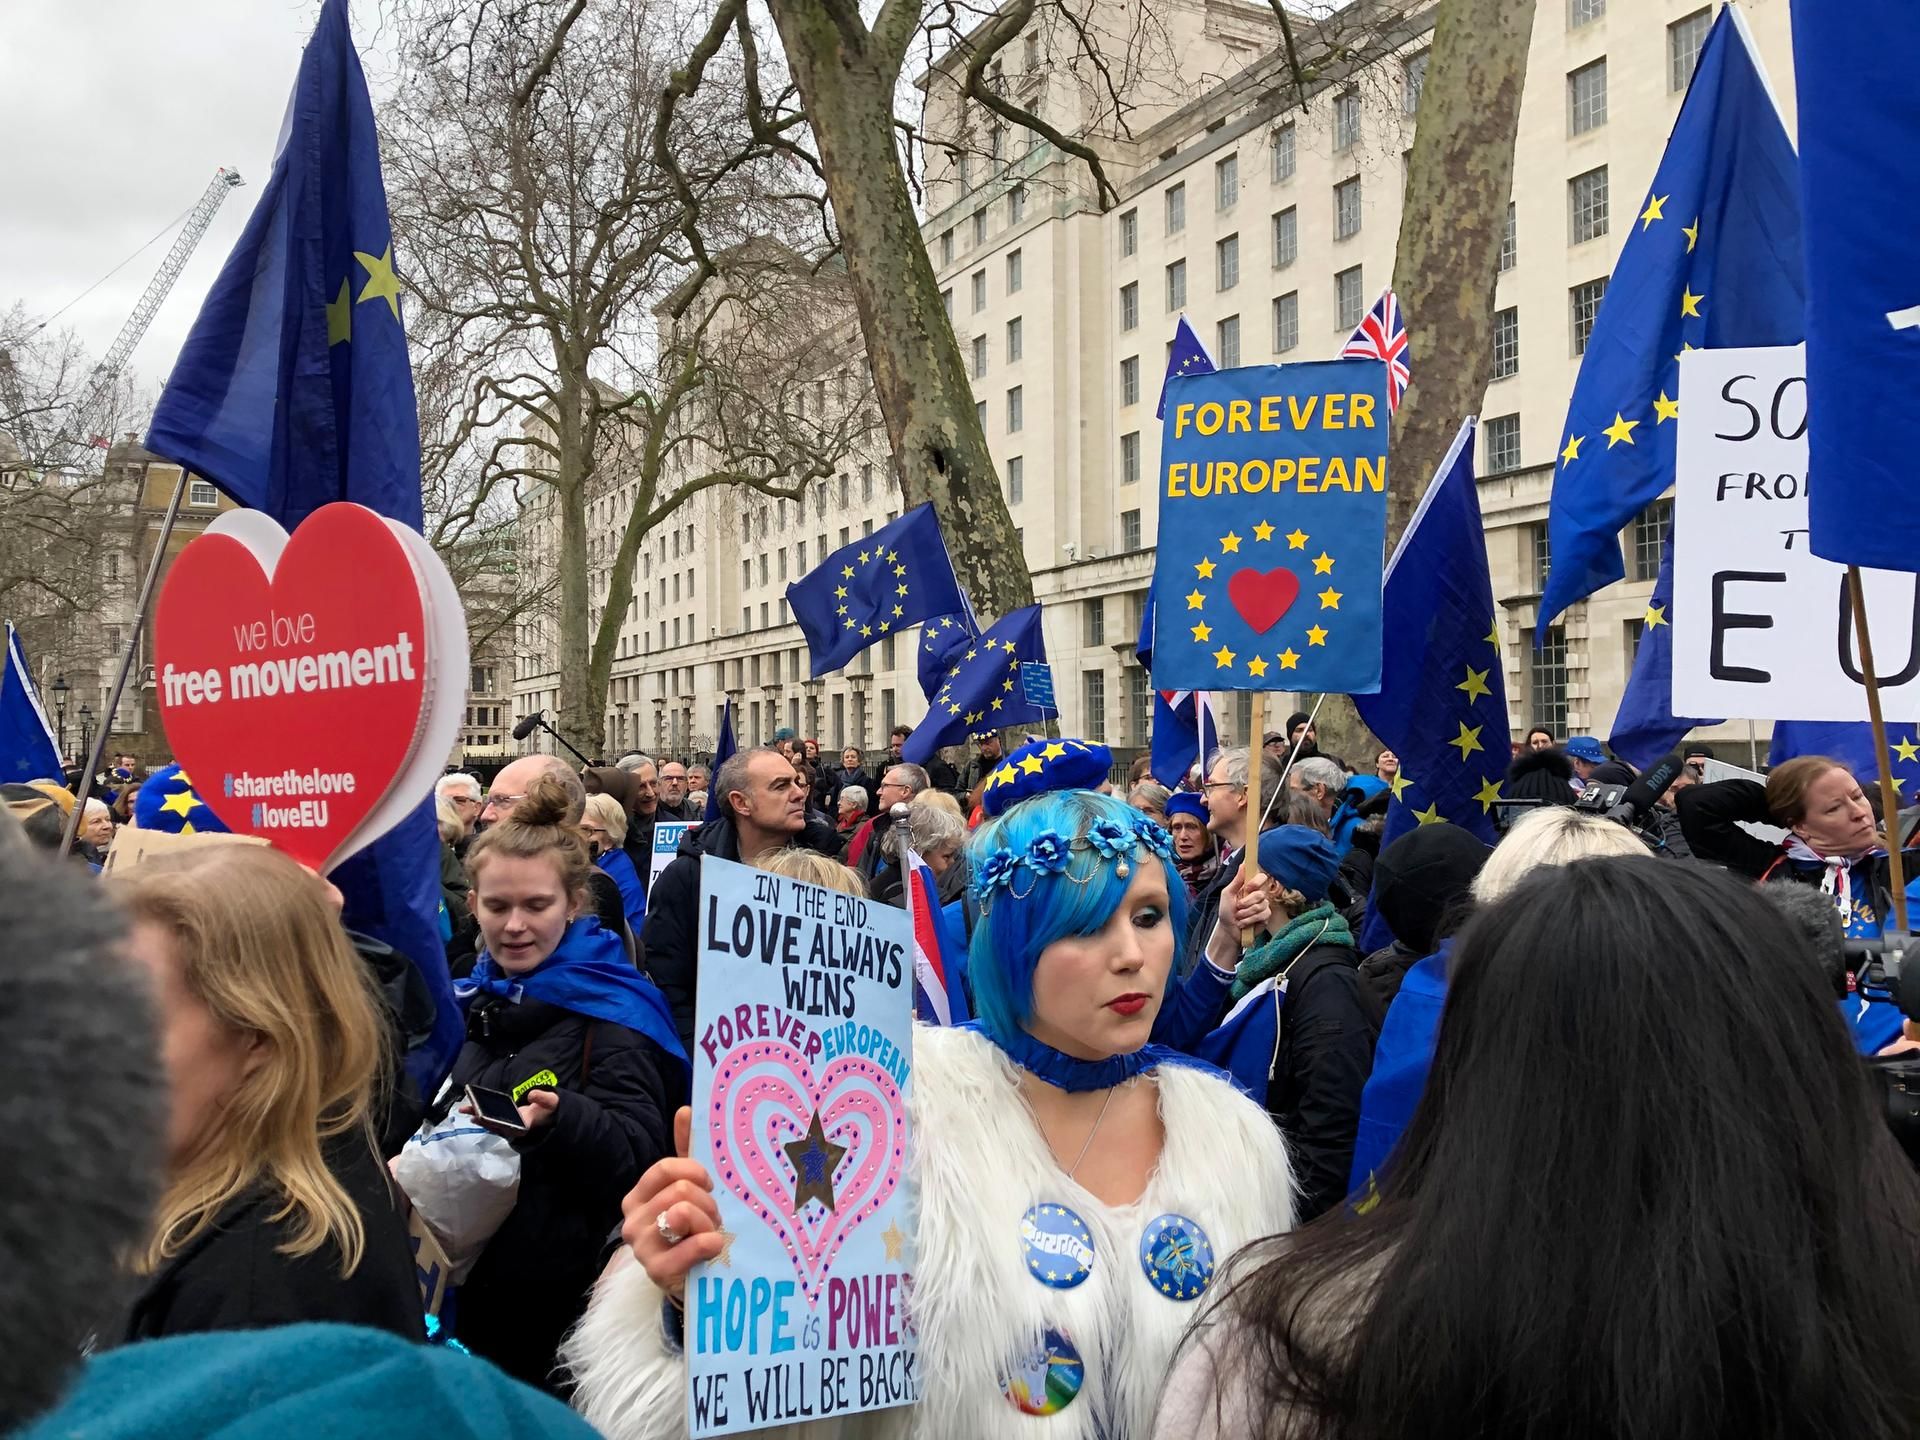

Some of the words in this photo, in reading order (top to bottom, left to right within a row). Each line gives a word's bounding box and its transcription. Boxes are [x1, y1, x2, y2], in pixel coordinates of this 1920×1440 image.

[1175, 393, 1376, 439] FOREVER
[1168, 456, 1386, 498] EUROPEAN
[1716, 472, 1809, 501] FRO
[233, 621, 267, 653] we
[270, 609, 316, 648] love
[163, 663, 222, 707] free
[229, 632, 416, 700] movement
[223, 767, 356, 799] #sharethelove
[251, 800, 329, 829] #loveEU
[656, 828, 676, 845] EU
[753, 874, 781, 909] IN
[791, 882, 827, 920] THE
[707, 894, 802, 966] LOVE
[808, 922, 904, 989] ALWAYS
[782, 966, 856, 1019] WINS
[699, 1004, 823, 1069] FOREVER
[821, 1020, 911, 1090] EUROPEAN
[697, 1276, 796, 1356] HOPE
[802, 1314, 821, 1351] is
[693, 1373, 729, 1431] WE
[744, 1362, 813, 1423] WILL
[820, 1357, 850, 1414] BE
